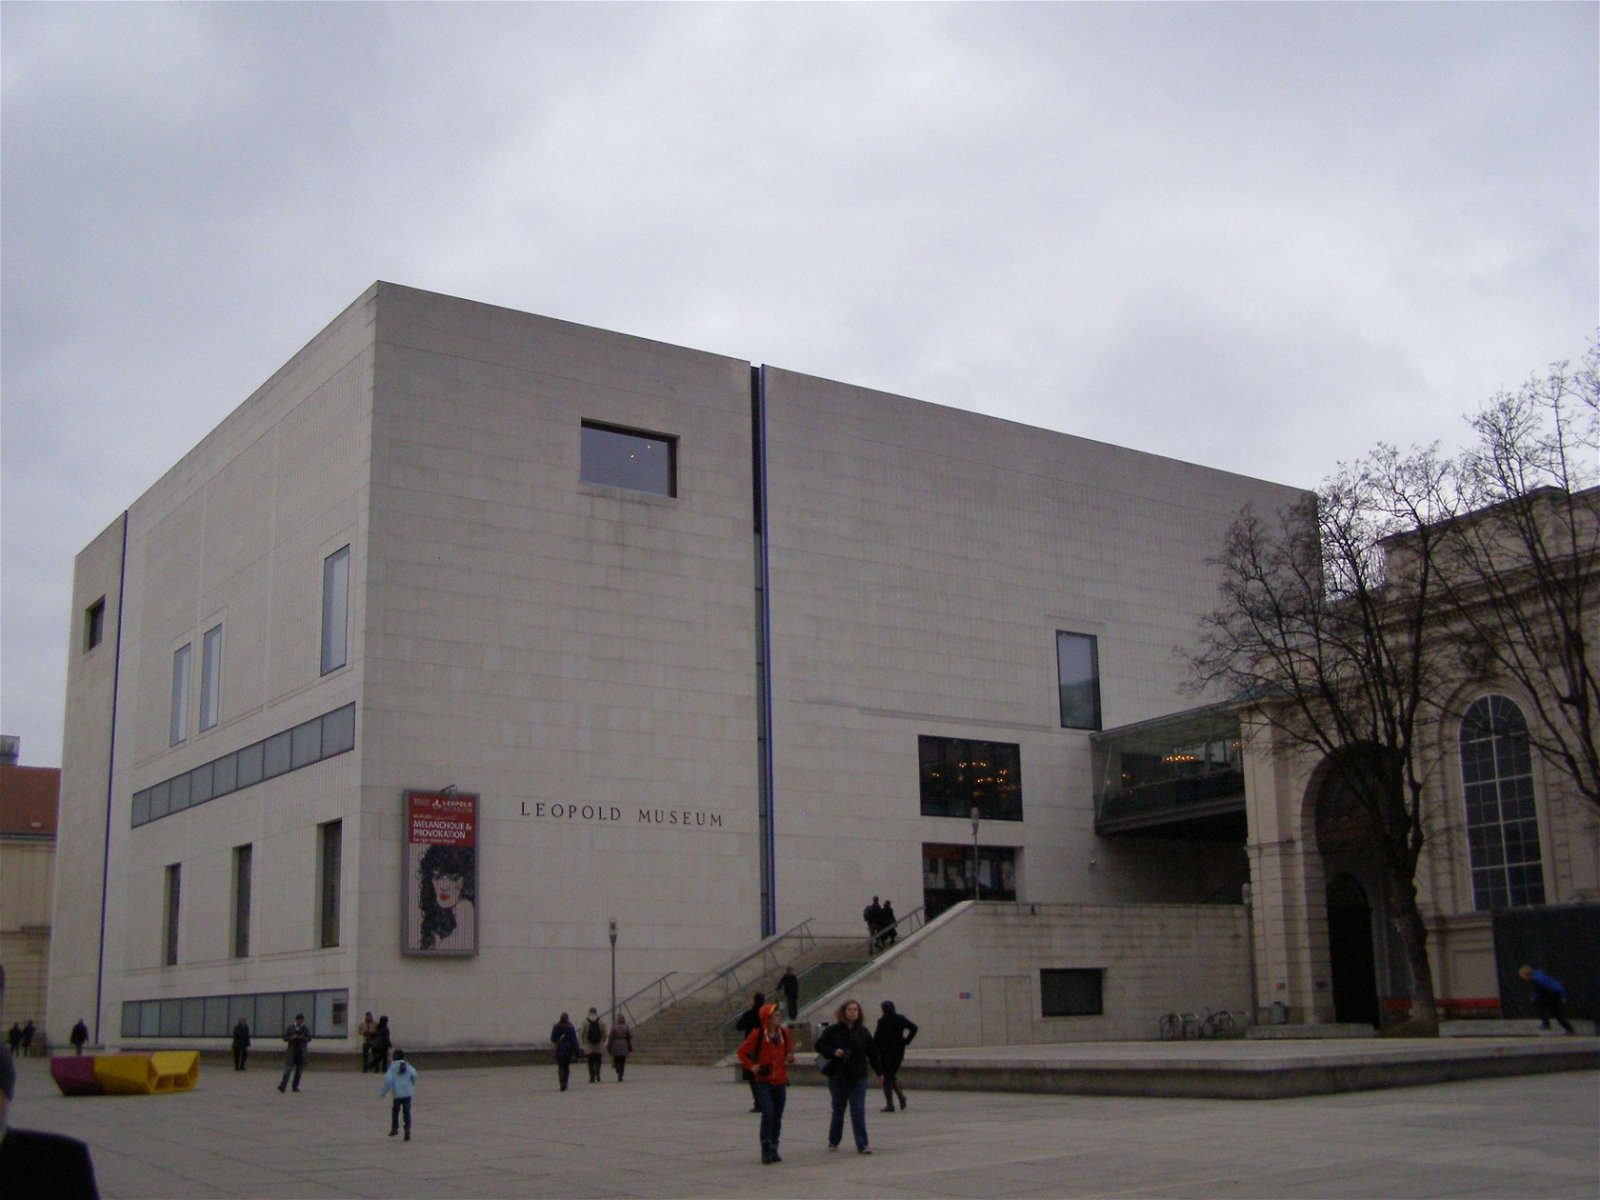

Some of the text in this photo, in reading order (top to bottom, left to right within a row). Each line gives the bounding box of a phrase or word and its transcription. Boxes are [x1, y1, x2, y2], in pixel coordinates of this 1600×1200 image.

[442, 800, 473, 808] LEOPOLD
[521, 802, 723, 827] LEOPOLD MUSEUM
[465, 823, 472, 831] &
[413, 828, 466, 839] PROVOKATION
